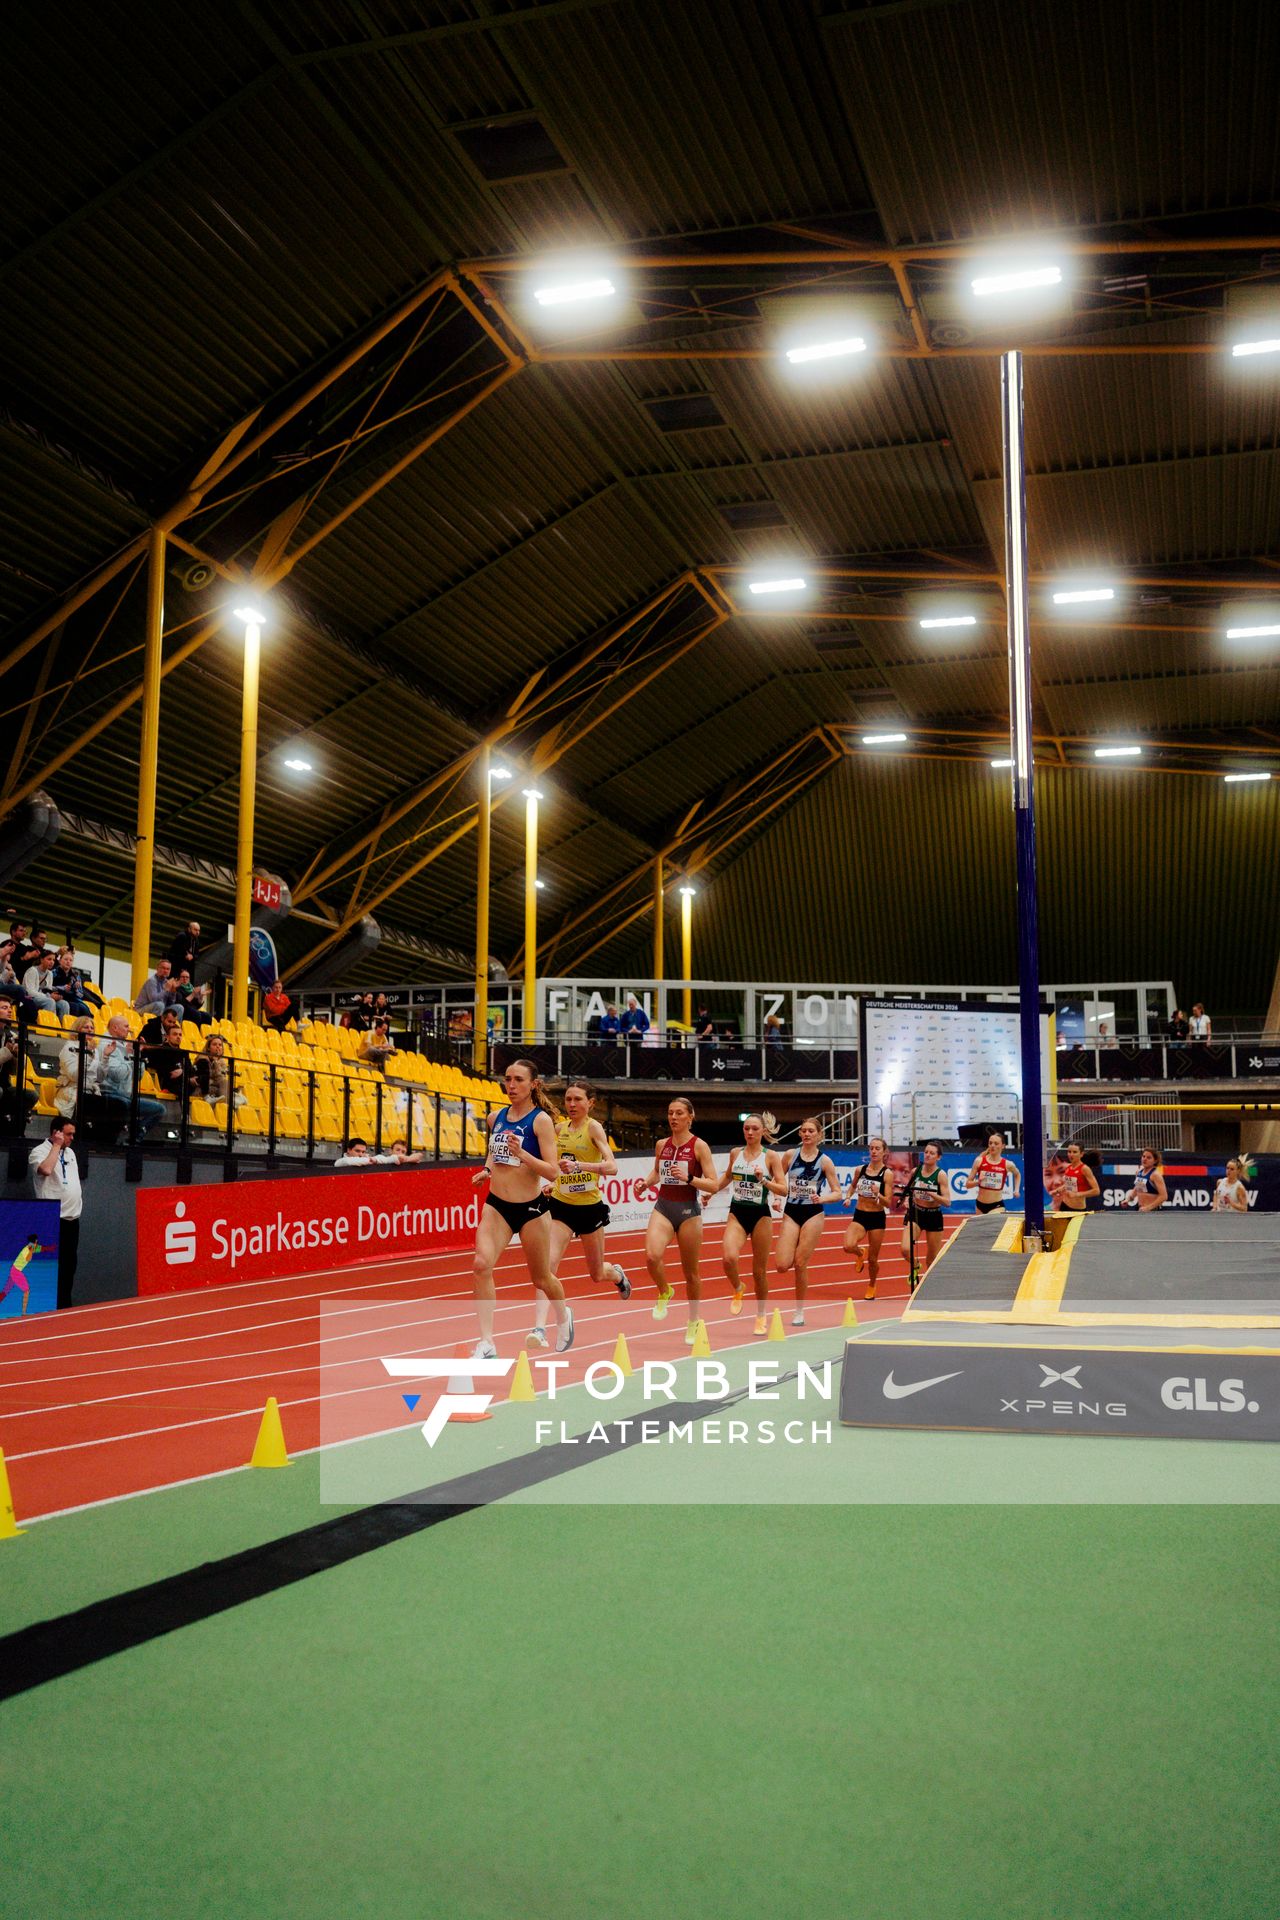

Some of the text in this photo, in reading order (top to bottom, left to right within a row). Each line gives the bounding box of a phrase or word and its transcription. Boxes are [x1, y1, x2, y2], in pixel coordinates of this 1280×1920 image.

[549, 991, 651, 1023] FAN
[894, 1002, 945, 1010] MEISTERSCHAFTEN
[1004, 1131, 1015, 1149] 1
[560, 1173, 592, 1185] BURKARD
[739, 1181, 755, 1189] GLS
[795, 1179, 809, 1187] GLS
[211, 1194, 478, 1267] Sparkasse Dortmund
[1000, 1398, 1127, 1417] XPENG
